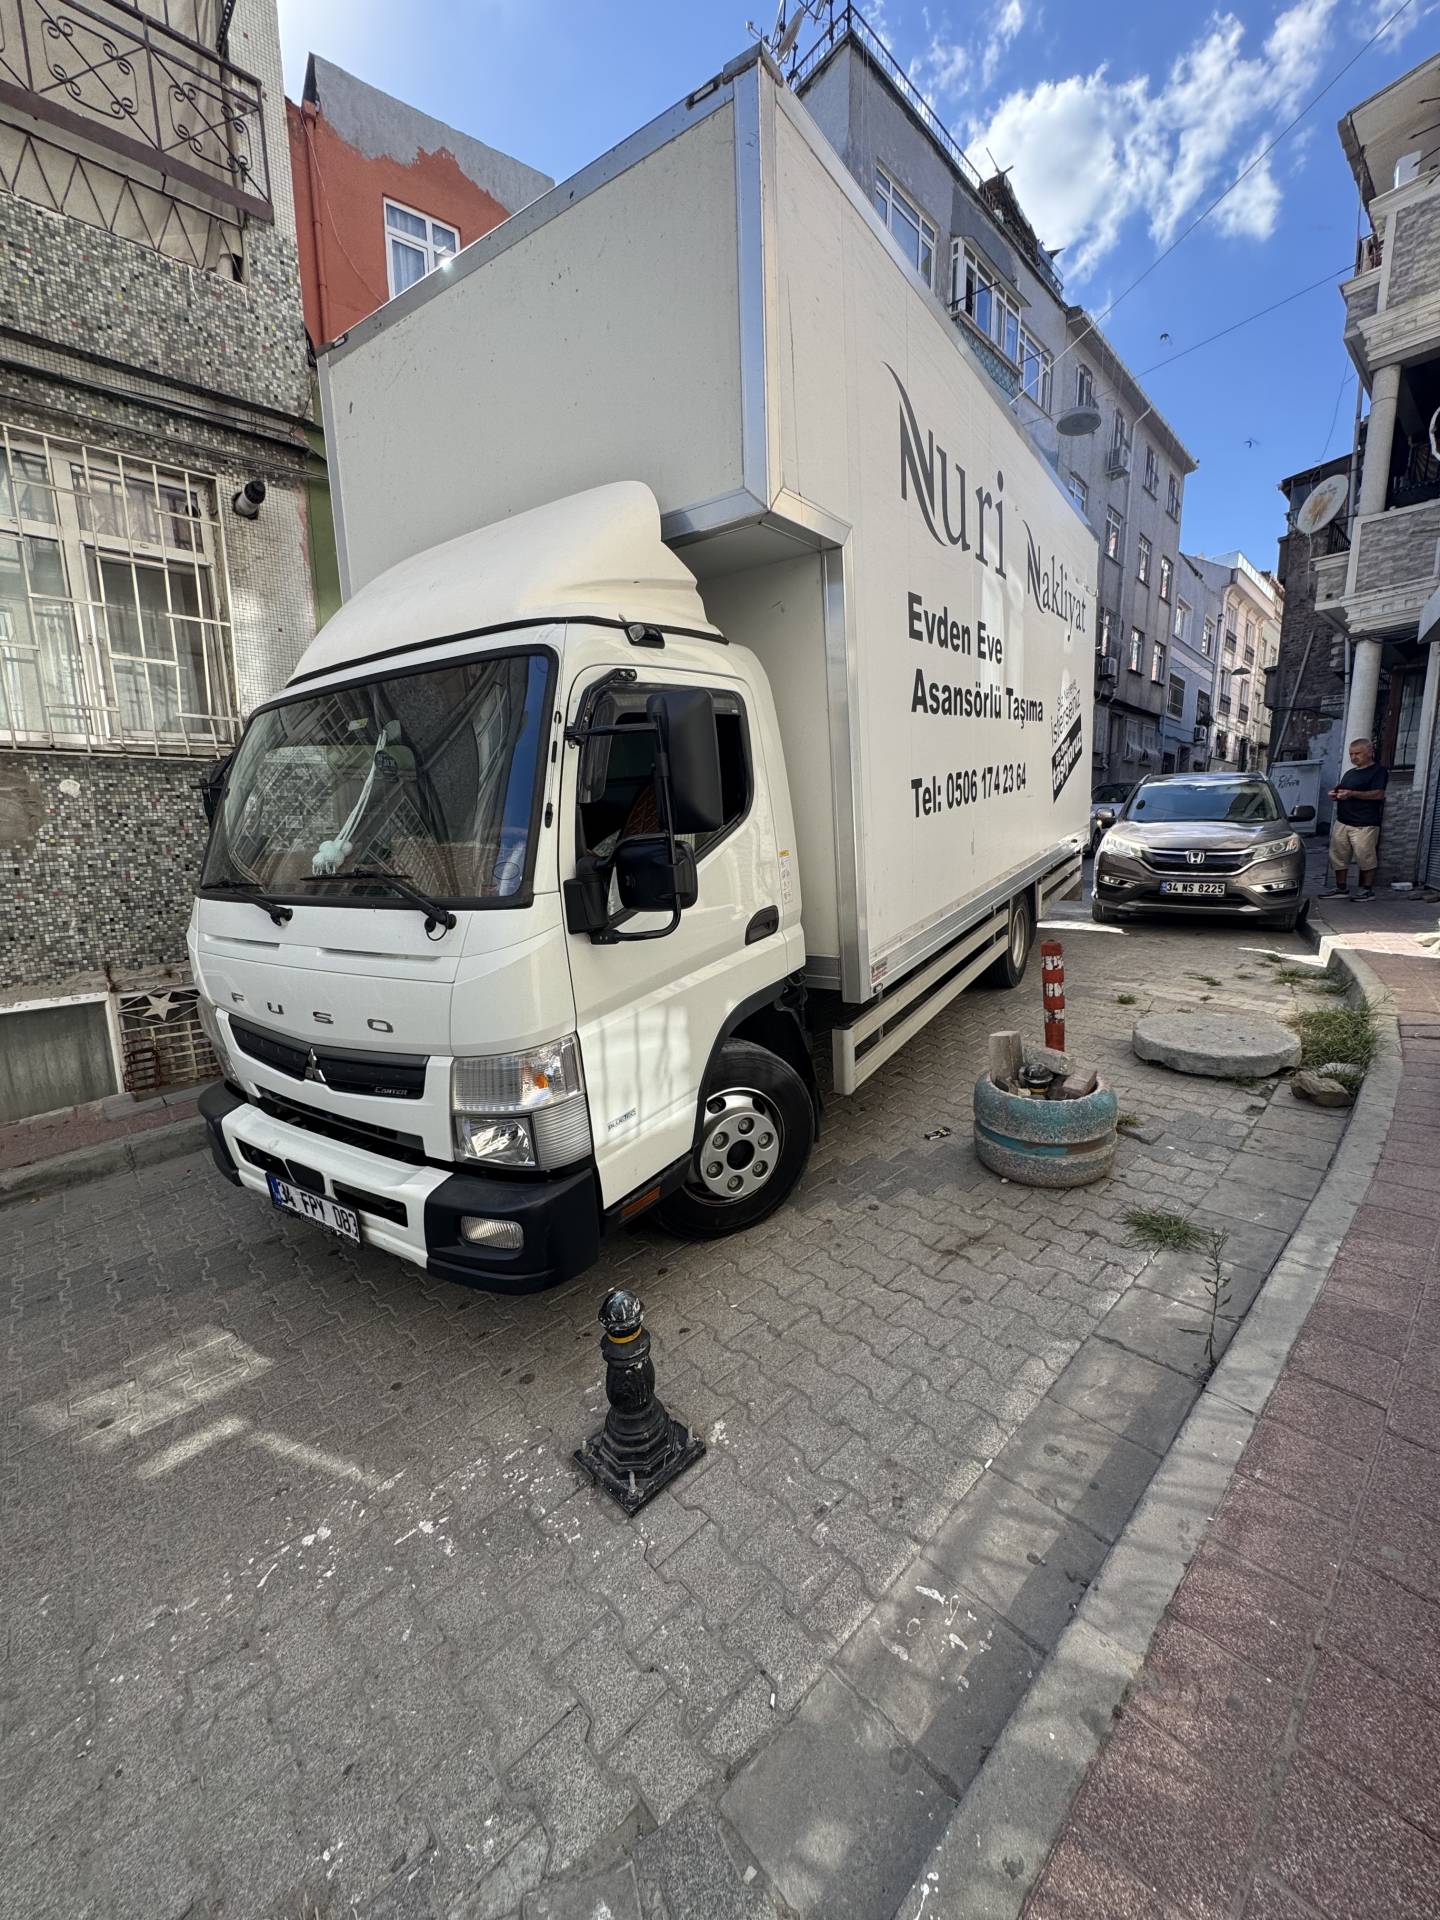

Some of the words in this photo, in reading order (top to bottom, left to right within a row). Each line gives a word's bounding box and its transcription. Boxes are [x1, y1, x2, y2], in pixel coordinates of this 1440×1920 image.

[881, 361, 1007, 580] Nuri
[1022, 520, 1086, 642] Nakliyat
[907, 591, 971, 656] Evden
[977, 620, 1003, 665] Eve
[911, 668, 1002, 719] Asansörlü
[1005, 687, 1043, 729] Taşıma
[911, 775, 942, 818] Tel:
[946, 768, 978, 810] 0506
[981, 765, 1000, 798] 174
[1002, 763, 1014, 794] 23
[1016, 762, 1026, 789] 64
[1167, 883, 1178, 892] 34
[1182, 883, 1194, 893] NS
[1198, 884, 1224, 894] 8225
[231, 991, 394, 1034] FUSO
[300, 1191, 326, 1221] FPY
[332, 1205, 359, 1239] 083
